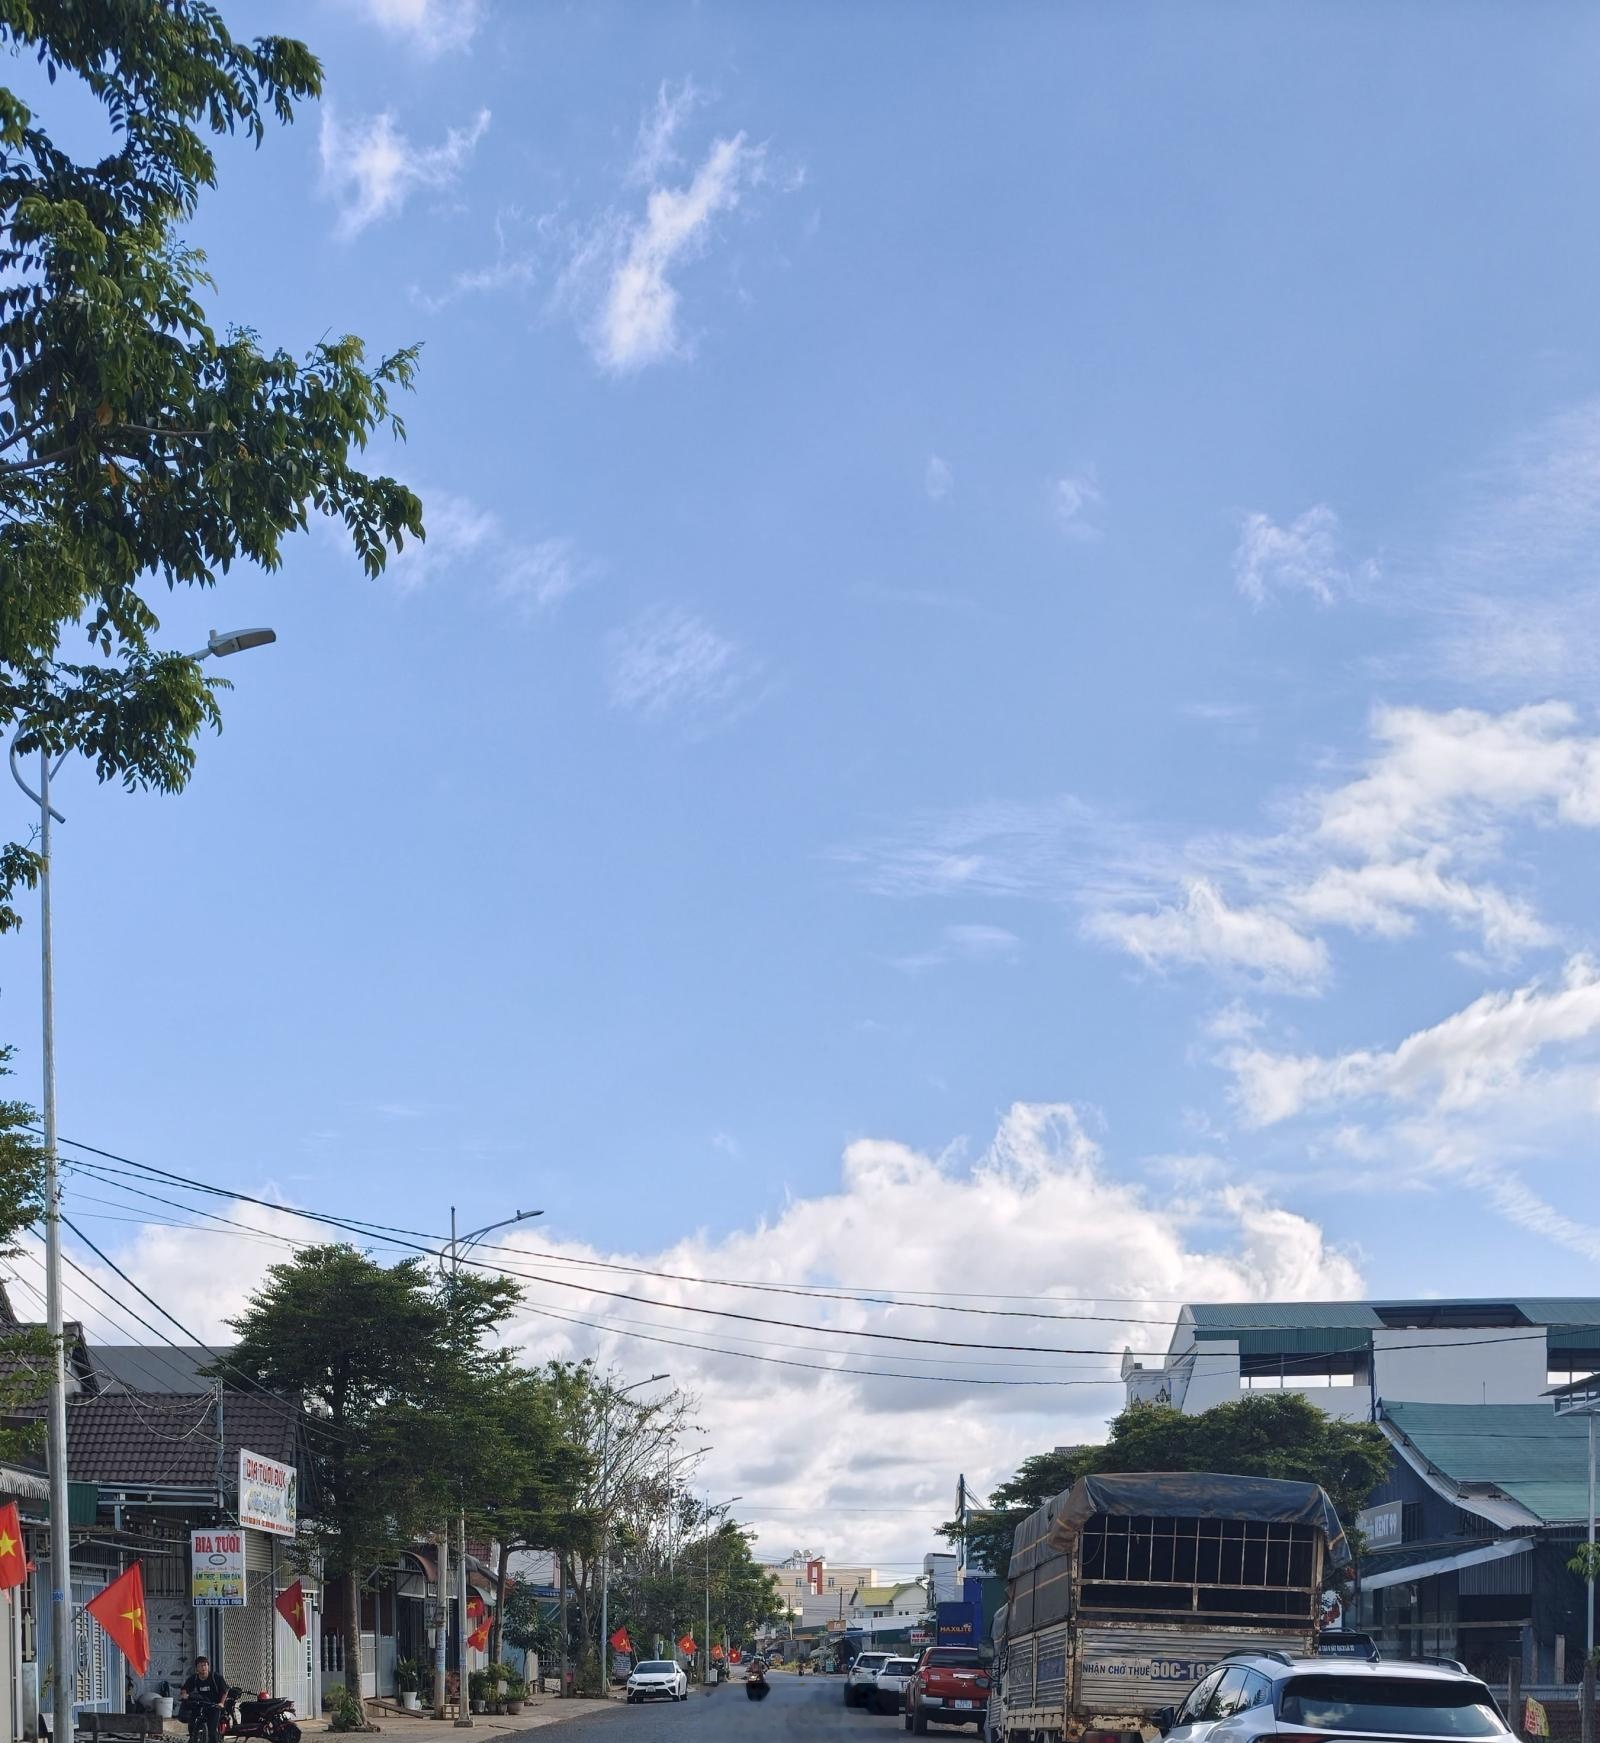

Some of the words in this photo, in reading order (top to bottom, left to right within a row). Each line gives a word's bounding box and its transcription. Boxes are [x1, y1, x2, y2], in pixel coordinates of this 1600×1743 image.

[195, 1536, 213, 1553] BIA
[1082, 1663, 1106, 1675] NHẬN
[1108, 1662, 1126, 1675] CHỞ
[1128, 1665, 1150, 1676] THUÊ
[1151, 1661, 1214, 1681] 60C-19
